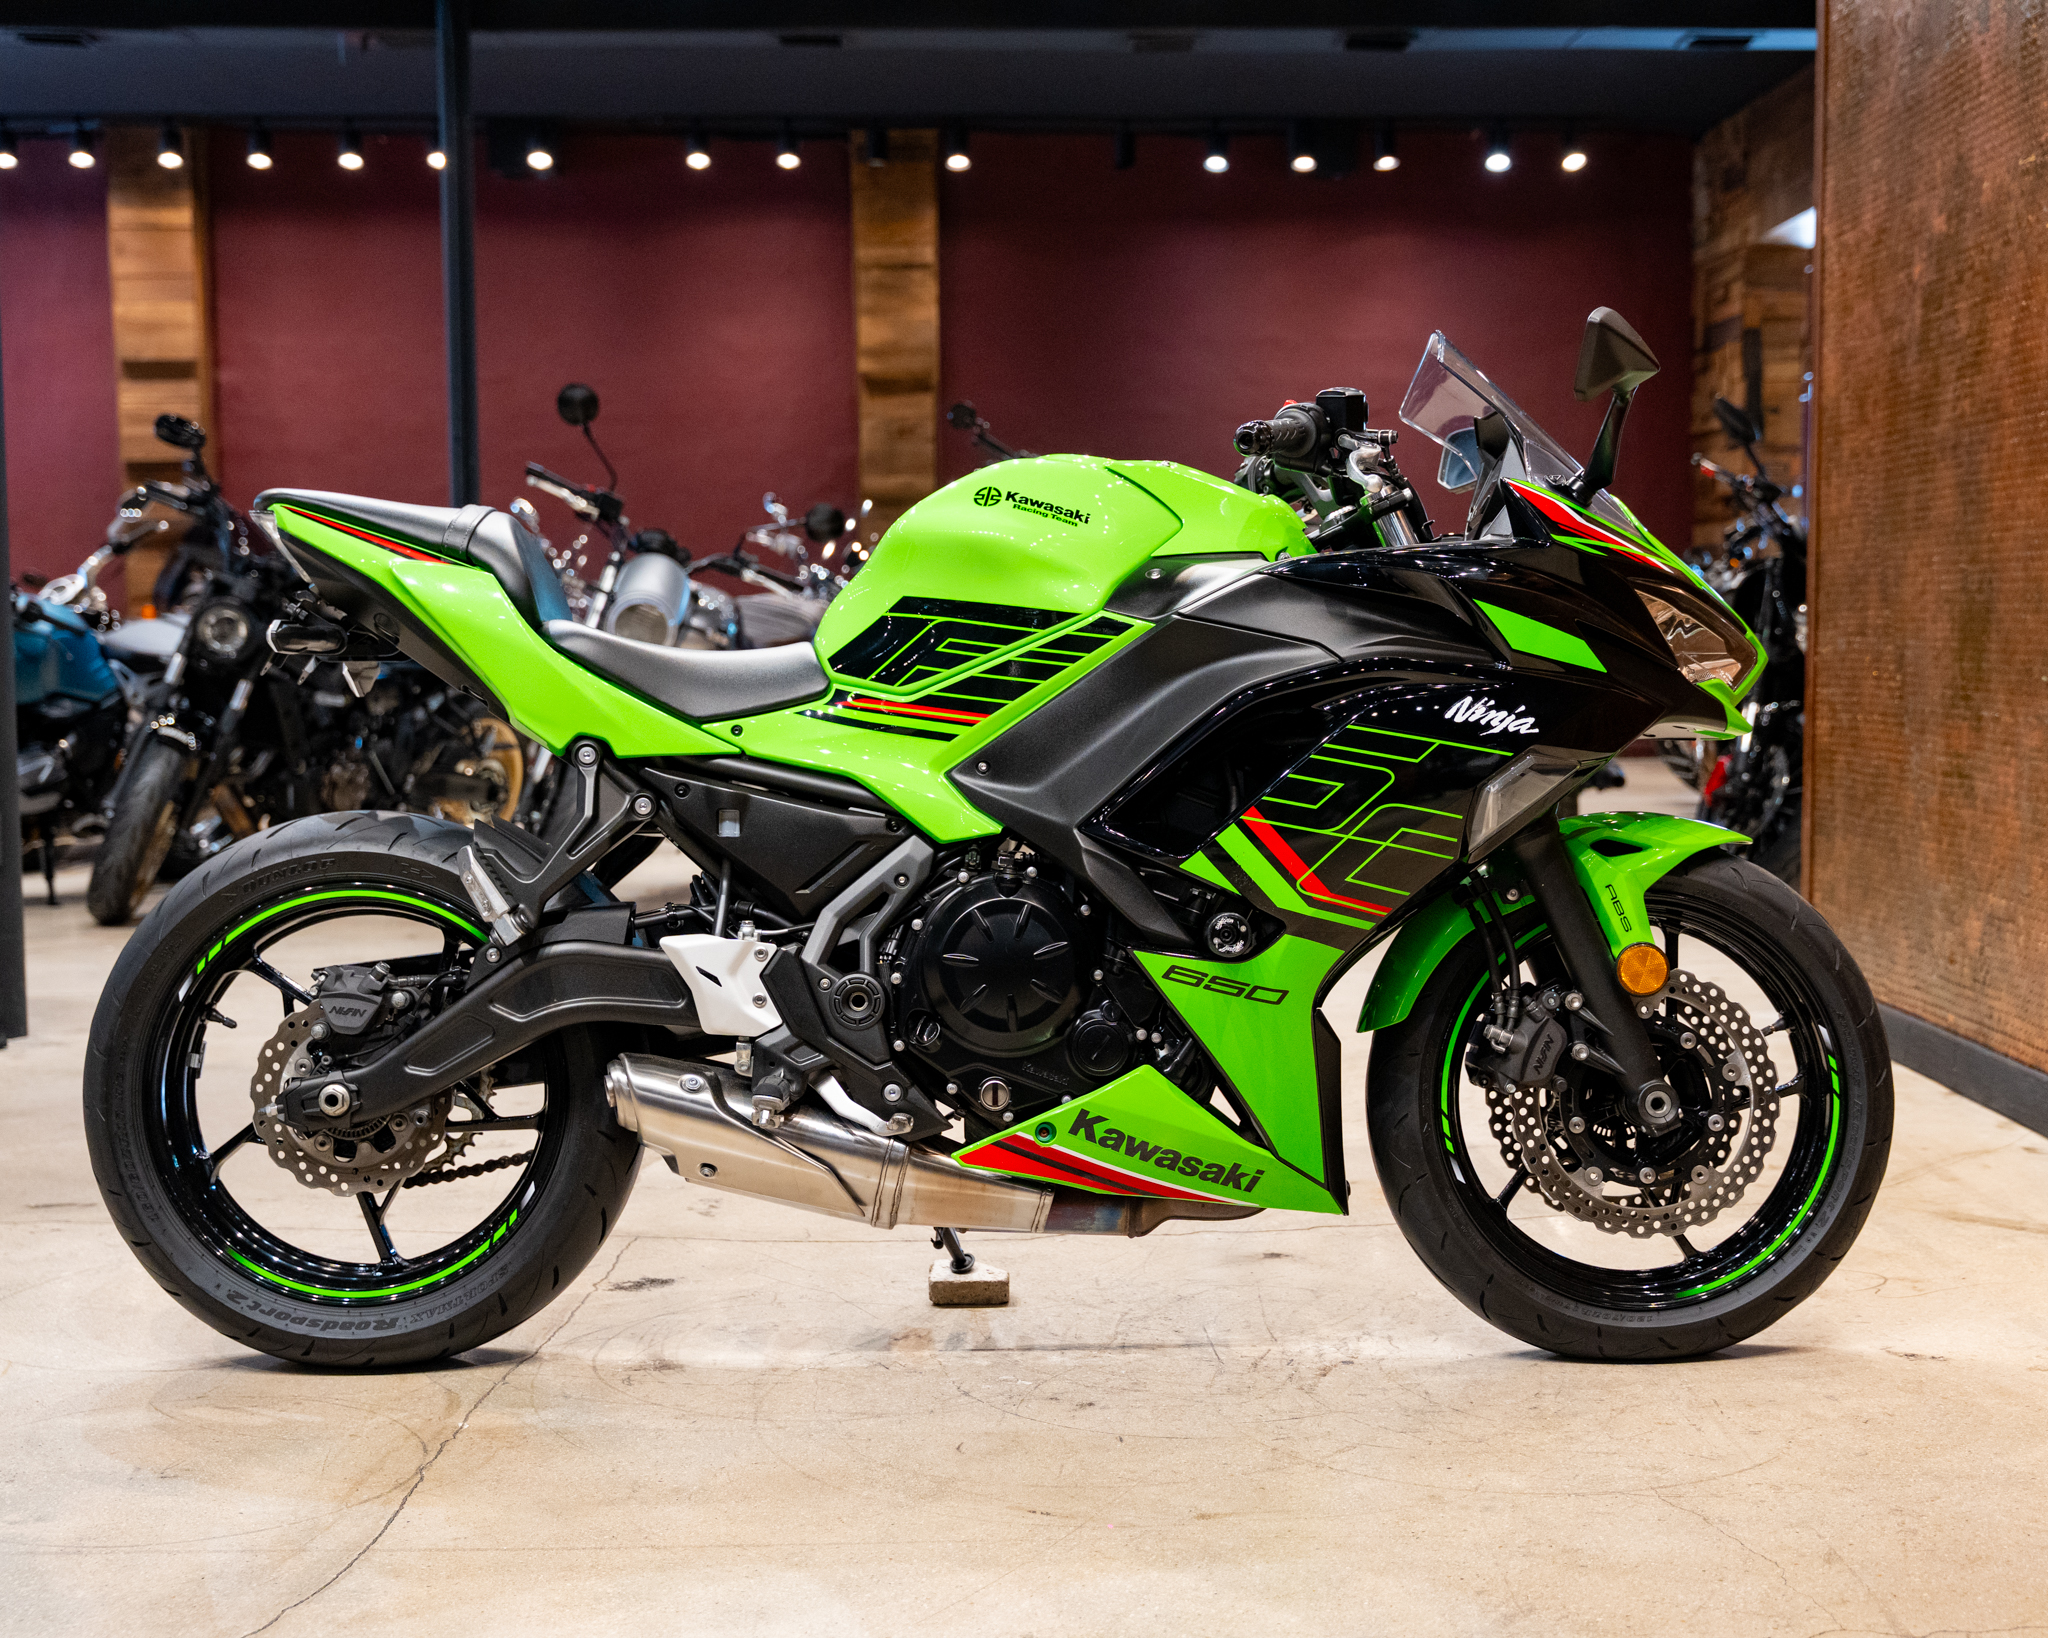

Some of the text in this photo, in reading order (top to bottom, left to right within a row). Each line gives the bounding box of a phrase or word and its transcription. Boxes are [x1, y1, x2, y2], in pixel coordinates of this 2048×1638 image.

[1005, 491, 1090, 524] Kawasaki
[1012, 504, 1078, 527] Racing Team
[1445, 696, 1539, 736] Ninja
[242, 858, 336, 893] DUNLOP
[1605, 884, 1632, 932] ABS
[1162, 965, 1289, 1005] 650
[1068, 1108, 1265, 1193] Kawasaki
[226, 1288, 251, 1308] 2
[246, 1298, 401, 1332] Roadsport
